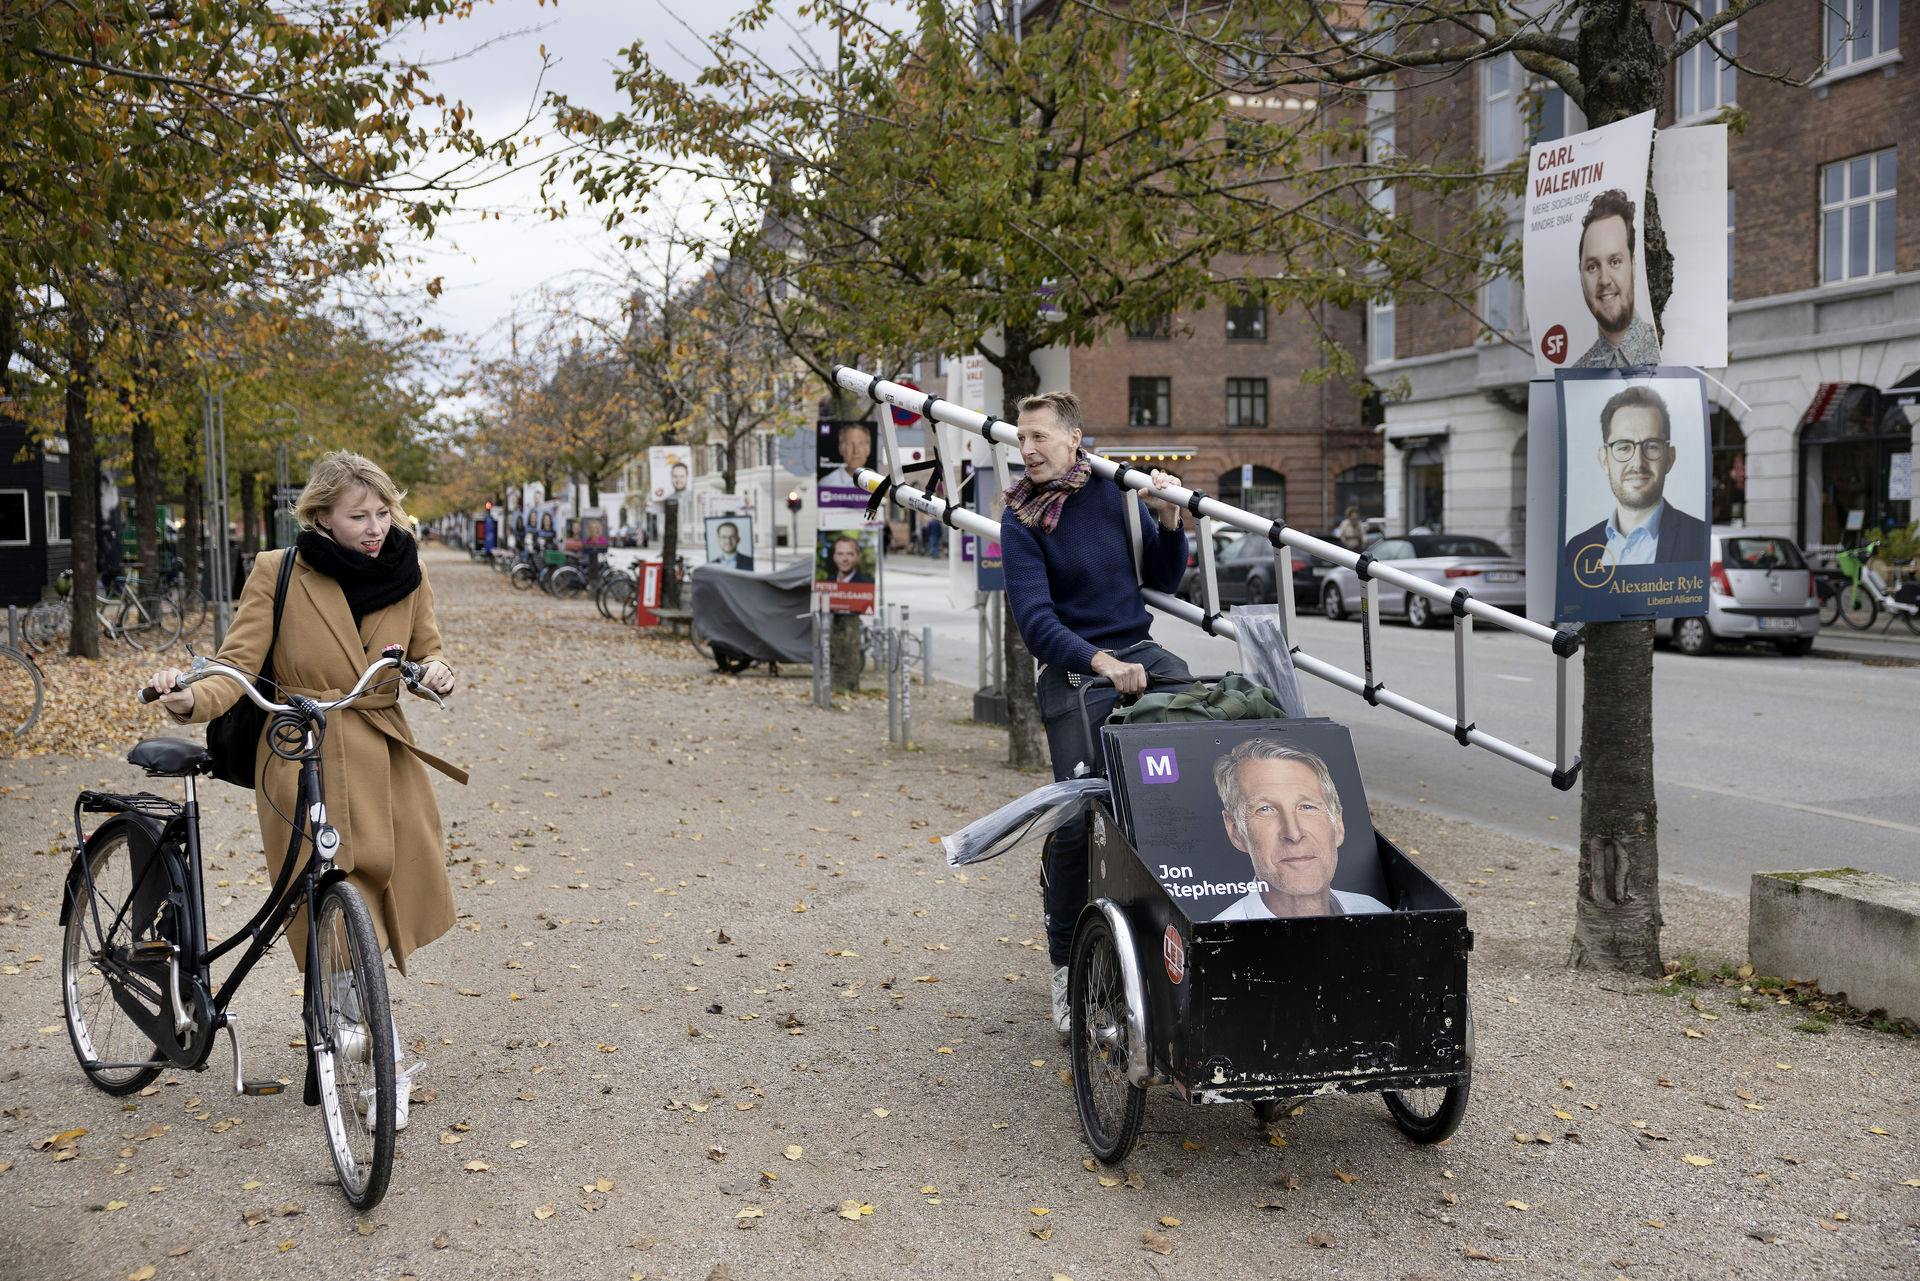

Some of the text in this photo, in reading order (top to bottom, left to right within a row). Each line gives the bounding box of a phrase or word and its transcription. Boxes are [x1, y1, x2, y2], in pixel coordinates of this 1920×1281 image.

[1537, 145, 1575, 171] CARL
[1535, 161, 1604, 198] VALENTIN
[1532, 192, 1590, 215] MERE SOCIALISME
[1531, 212, 1574, 231] MINDRE SNAK
[1547, 334, 1564, 355] SF
[1585, 559, 1605, 574] LA
[1609, 575, 1704, 594] Alexander Ryle
[1648, 595, 1703, 606] Liberal Alliance
[1146, 755, 1172, 776] M
[1159, 864, 1193, 879] Jon
[1163, 880, 1269, 900] Stephensen
